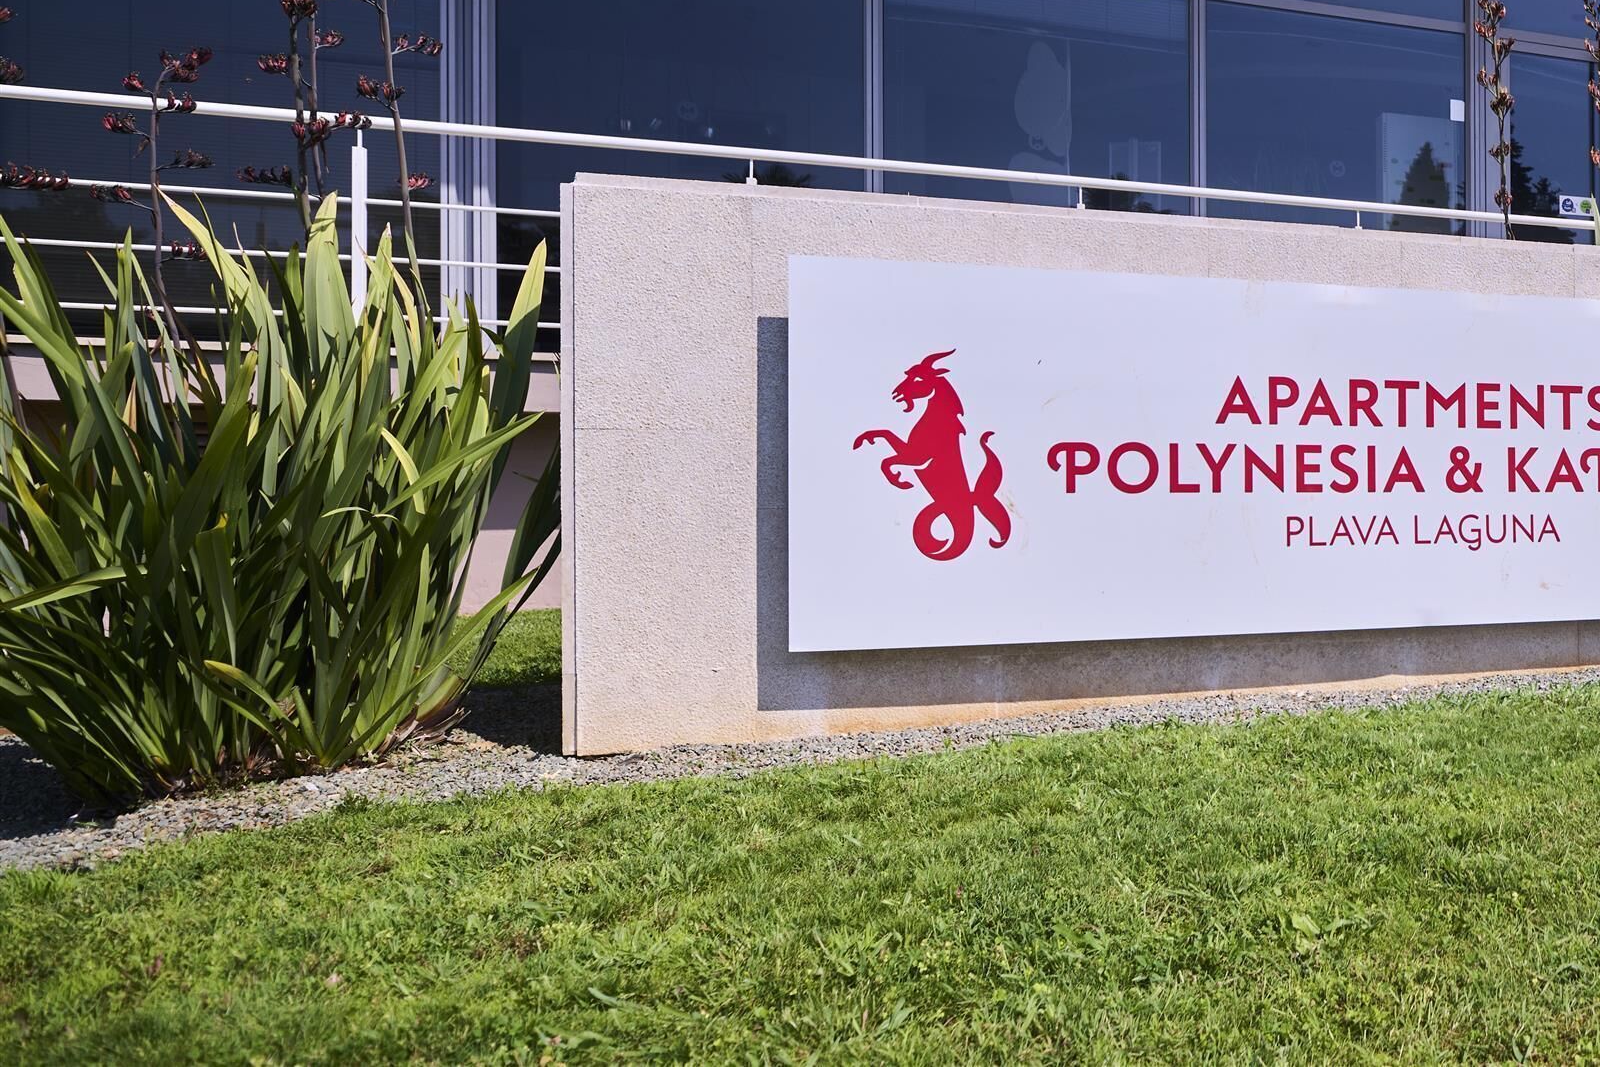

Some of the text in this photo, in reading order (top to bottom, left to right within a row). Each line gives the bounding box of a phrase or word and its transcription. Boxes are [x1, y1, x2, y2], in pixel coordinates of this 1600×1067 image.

[1046, 441, 1425, 495] POLYNESIA
[1444, 445, 1484, 494] &
[1286, 514, 1561, 551] PLAVA LAGUNA
